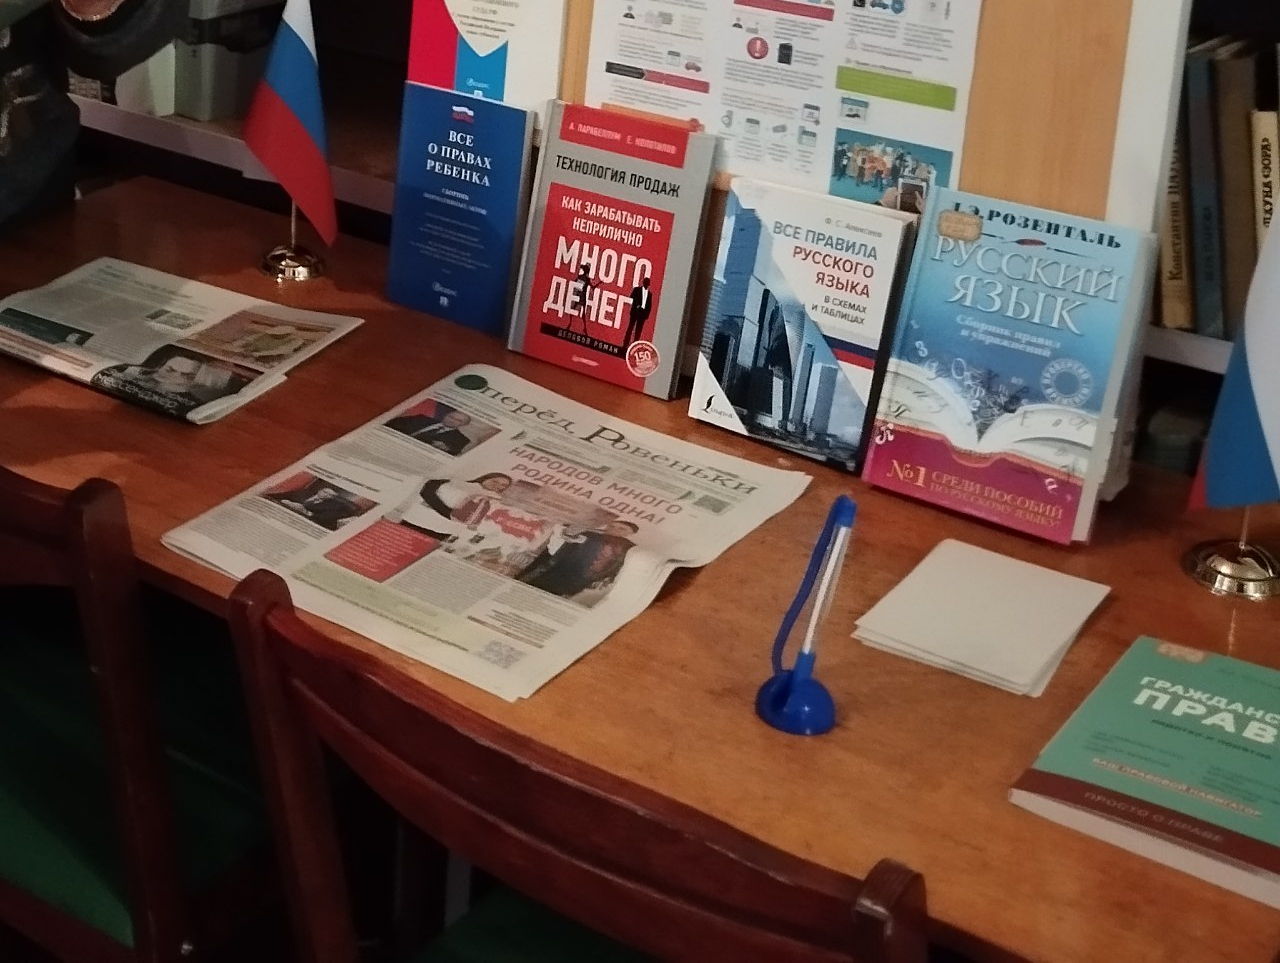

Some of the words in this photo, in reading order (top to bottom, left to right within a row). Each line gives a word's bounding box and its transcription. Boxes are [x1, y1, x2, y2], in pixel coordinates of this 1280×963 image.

[428, 143, 438, 155] О
[441, 145, 492, 170] ПРАВАХ
[448, 130, 474, 147] ВСЕ
[426, 159, 490, 187] РЕБЕНКА
[556, 155, 626, 184] ТЕХНОЛОГИЯ
[629, 173, 681, 198] ПРОДАЖ
[562, 195, 582, 212] КАК
[584, 201, 661, 233] ЗАРАБАТЫВАТЬ
[572, 217, 643, 248] НЕПРИЛИЧНО
[555, 235, 653, 287] МНОГО
[773, 221, 801, 240] ВСЕ
[804, 230, 878, 261] ПРАВИЛА
[1167, 201, 1183, 281] Константин
[793, 245, 874, 279] РУССКОГО
[931, 236, 1123, 302] РУССКИЙ
[542, 275, 634, 329] ДЕНЕГ
[815, 271, 870, 299] ЯЗЫКА
[824, 295, 830, 304] В
[832, 298, 868, 314] СХЕМАХ
[944, 274, 1087, 336] ЯЗЫК
[812, 303, 818, 311] И
[820, 305, 865, 325] ТАБЛИЦАХ
[558, 329, 591, 345] ДЕЛОВОЙ
[593, 340, 619, 354] РОМАН
[635, 351, 651, 362] 150
[579, 424, 759, 497] Ровеньки
[509, 445, 603, 486] НАРОДОВ
[607, 482, 684, 517] МНОГО
[511, 463, 594, 503] РОДИНА
[599, 495, 667, 526] ОДНА!
[931, 470, 981, 491] СРЕДИ
[984, 483, 1064, 519] ПОСОБИЙ
[1133, 688, 1278, 744] ПРАВ
